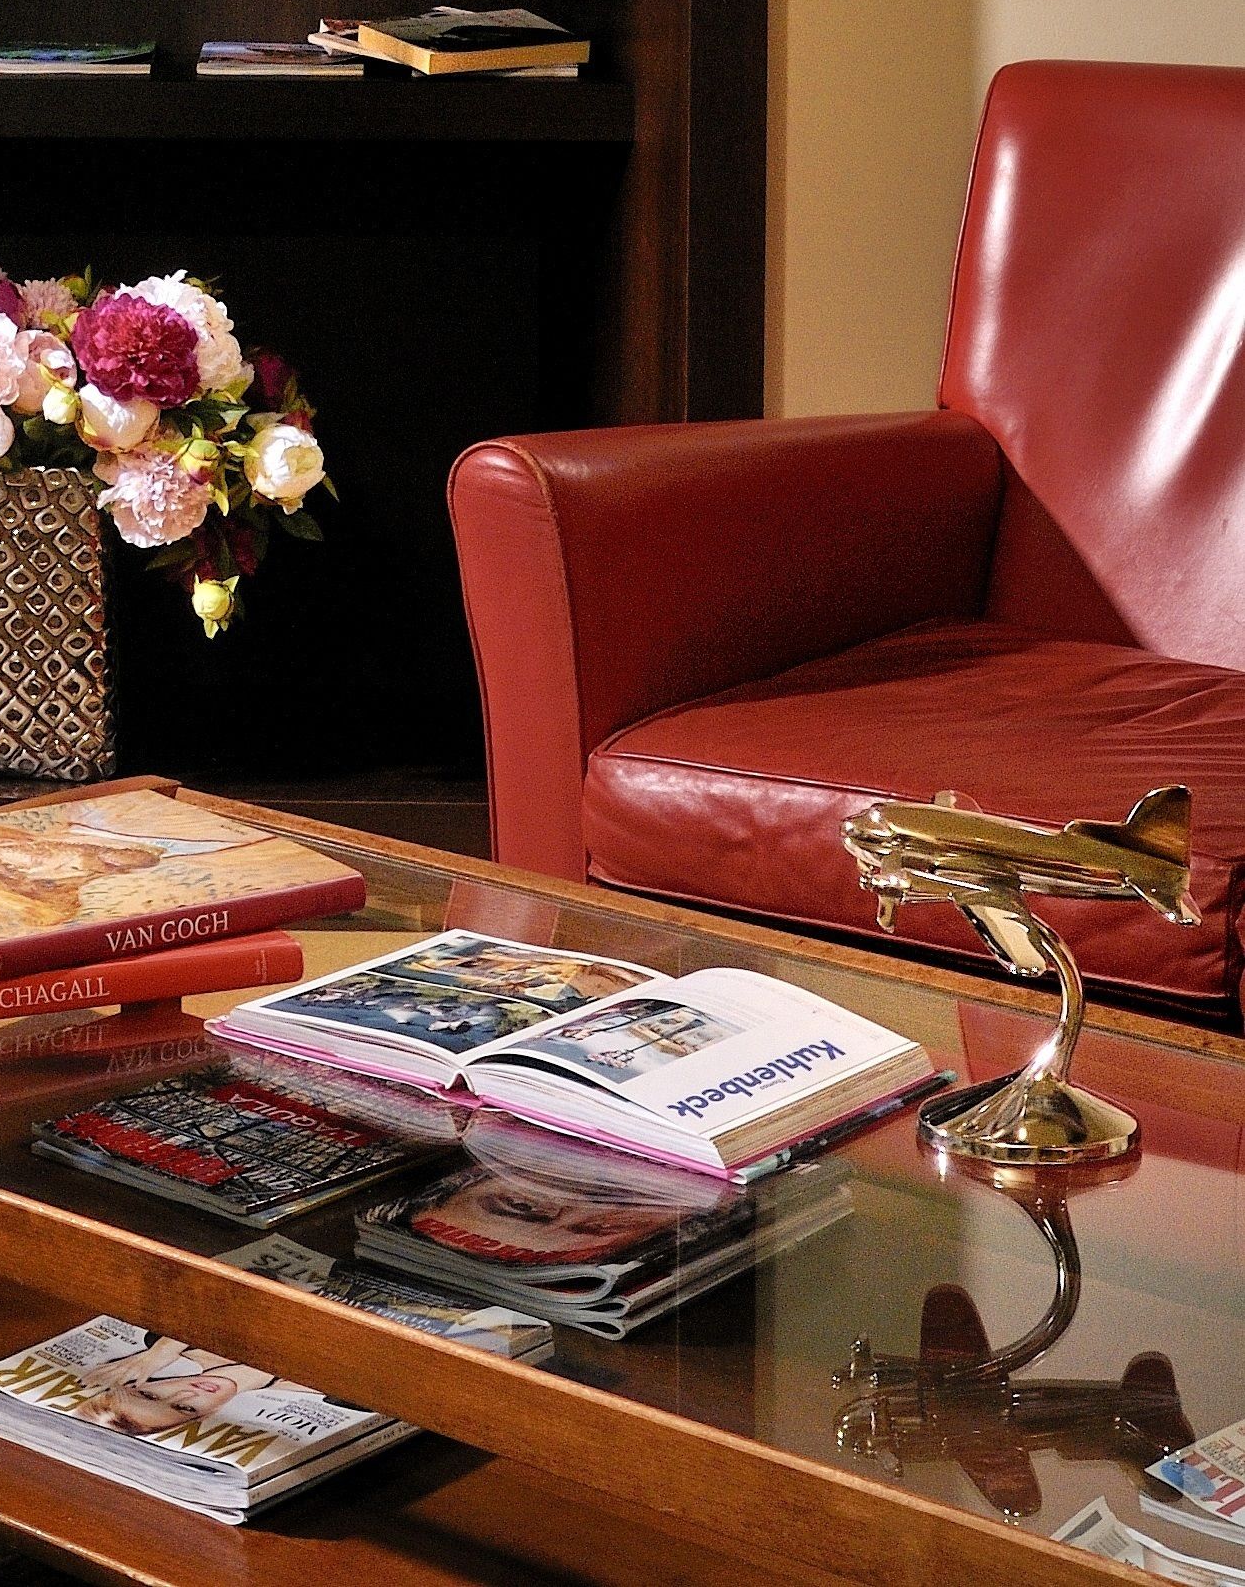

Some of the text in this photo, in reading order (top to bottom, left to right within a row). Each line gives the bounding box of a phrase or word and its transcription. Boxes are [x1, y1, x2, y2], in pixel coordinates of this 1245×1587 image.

[105, 911, 230, 954] VAN GOGH
[664, 1040, 846, 1120] Kuhlenbeck
[225, 1093, 362, 1147] L'AQUILA
